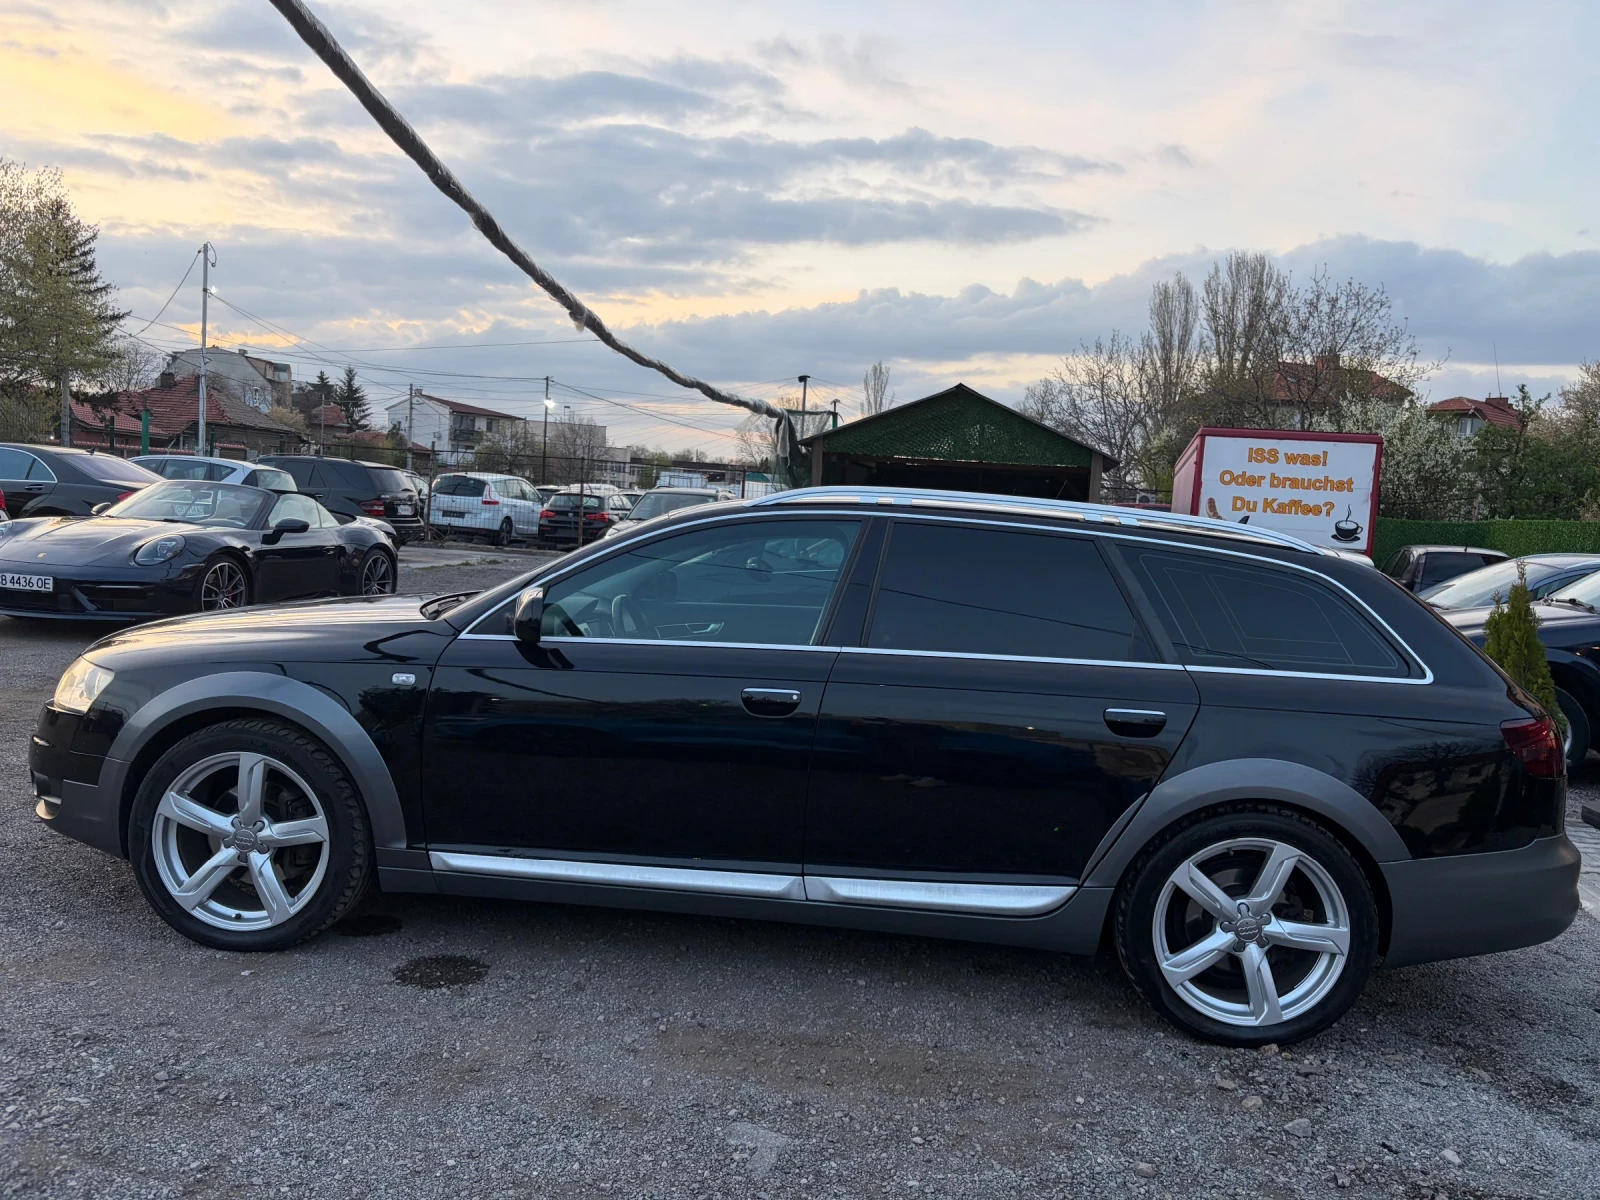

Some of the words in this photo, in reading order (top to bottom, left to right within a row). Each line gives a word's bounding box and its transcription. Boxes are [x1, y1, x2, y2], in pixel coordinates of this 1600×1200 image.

[1247, 447, 1279, 464] ISS
[1284, 450, 1328, 467] was!
[1219, 470, 1265, 487] Oder
[1269, 473, 1354, 492] brauchst
[1232, 496, 1257, 512] Du
[1262, 498, 1335, 517] Kaffee?
[0, 574, 7, 586] B
[10, 575, 34, 588] 4436
